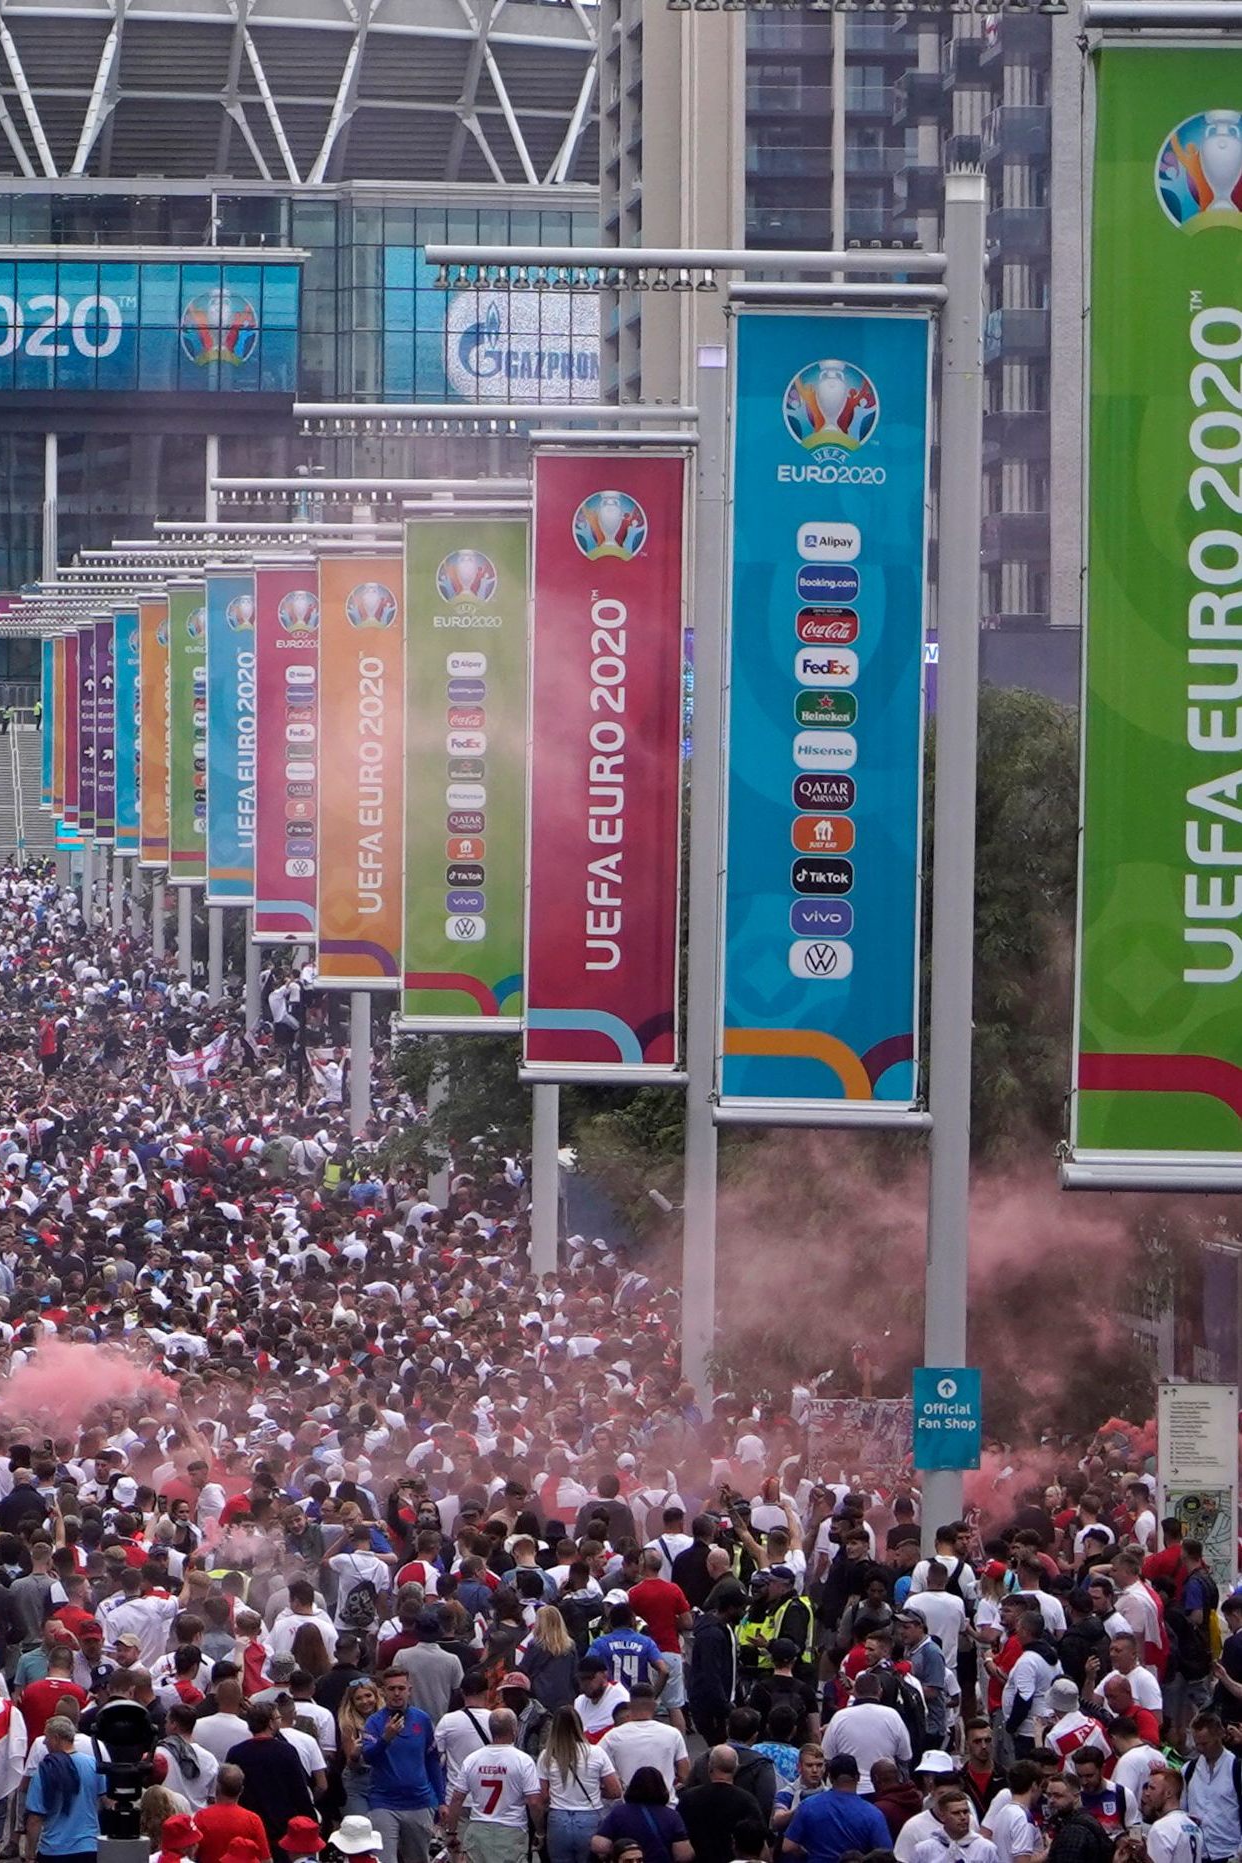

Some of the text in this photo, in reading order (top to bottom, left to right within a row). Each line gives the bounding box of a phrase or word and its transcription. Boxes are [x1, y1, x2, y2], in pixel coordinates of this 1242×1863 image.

[1189, 306, 1242, 513] 2020
[814, 450, 848, 463] UEFA
[818, 536, 853, 549] Alipay
[799, 577, 857, 590] Booking.com
[1186, 530, 1242, 752] EURO
[590, 598, 627, 714] 2020
[802, 659, 850, 675] FedEx
[238, 651, 255, 714] 2020
[801, 710, 850, 722] Heineken
[450, 738, 480, 749] FedEx
[797, 744, 852, 757] Hisense
[358, 656, 385, 914] UEFA EURO 2020
[588, 720, 625, 844] EURO
[799, 781, 848, 796] QATAR
[811, 795, 849, 804] AIRWAYS
[449, 815, 481, 826] QATAR
[457, 872, 483, 881] TikTok
[809, 871, 849, 883] TikTok
[1183, 768, 1242, 983] UEFA
[585, 851, 623, 971] UEFA
[802, 911, 842, 924] vivo
[923, 1403, 971, 1415] Official
[918, 1418, 977, 1432] Fan Shop
[608, 1640, 643, 1653] PHILLIPS
[612, 1654, 638, 1687] 14
[478, 1766, 507, 1775] KEEGAN
[480, 1780, 503, 1815] 7
